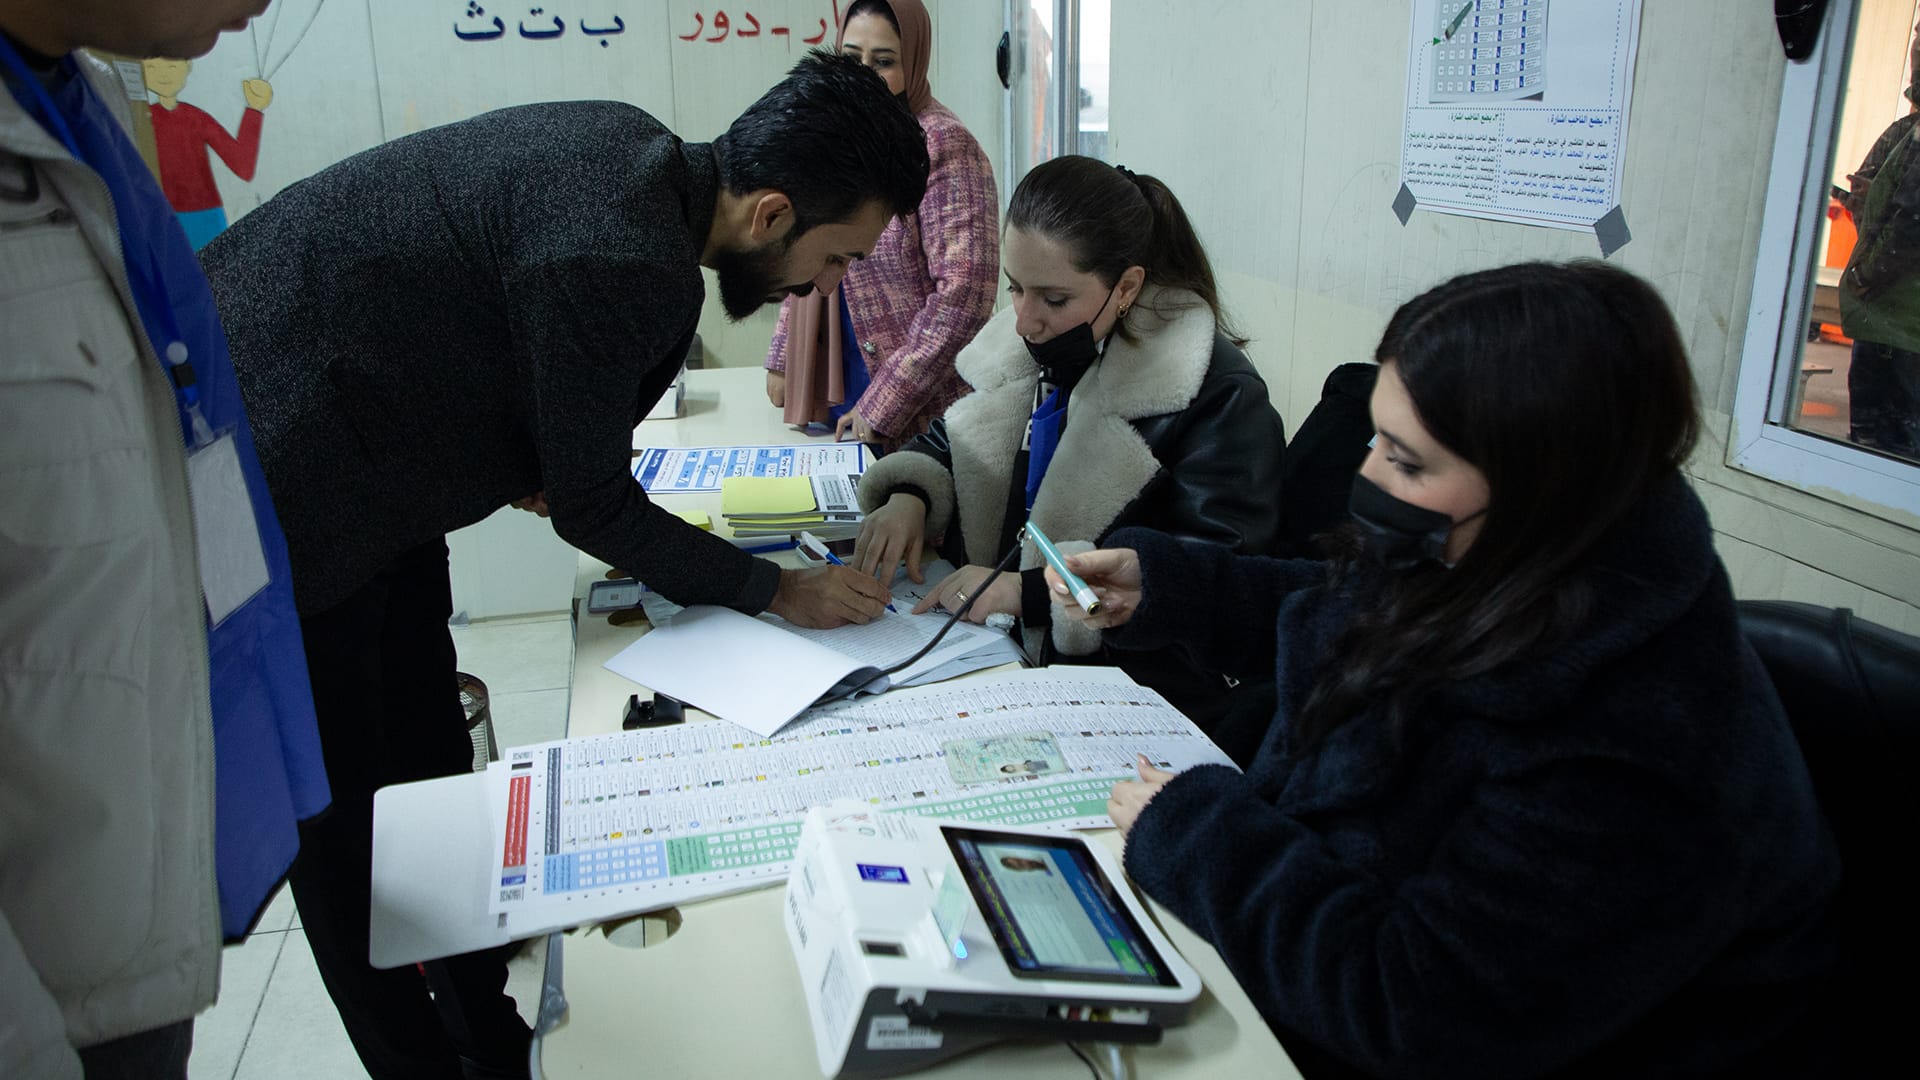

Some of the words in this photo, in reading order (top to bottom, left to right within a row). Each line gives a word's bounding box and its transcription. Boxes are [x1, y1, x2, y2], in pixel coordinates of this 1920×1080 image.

[454, 0, 506, 42] ث
[519, 7, 566, 40] ت
[580, 15, 625, 48] ب
